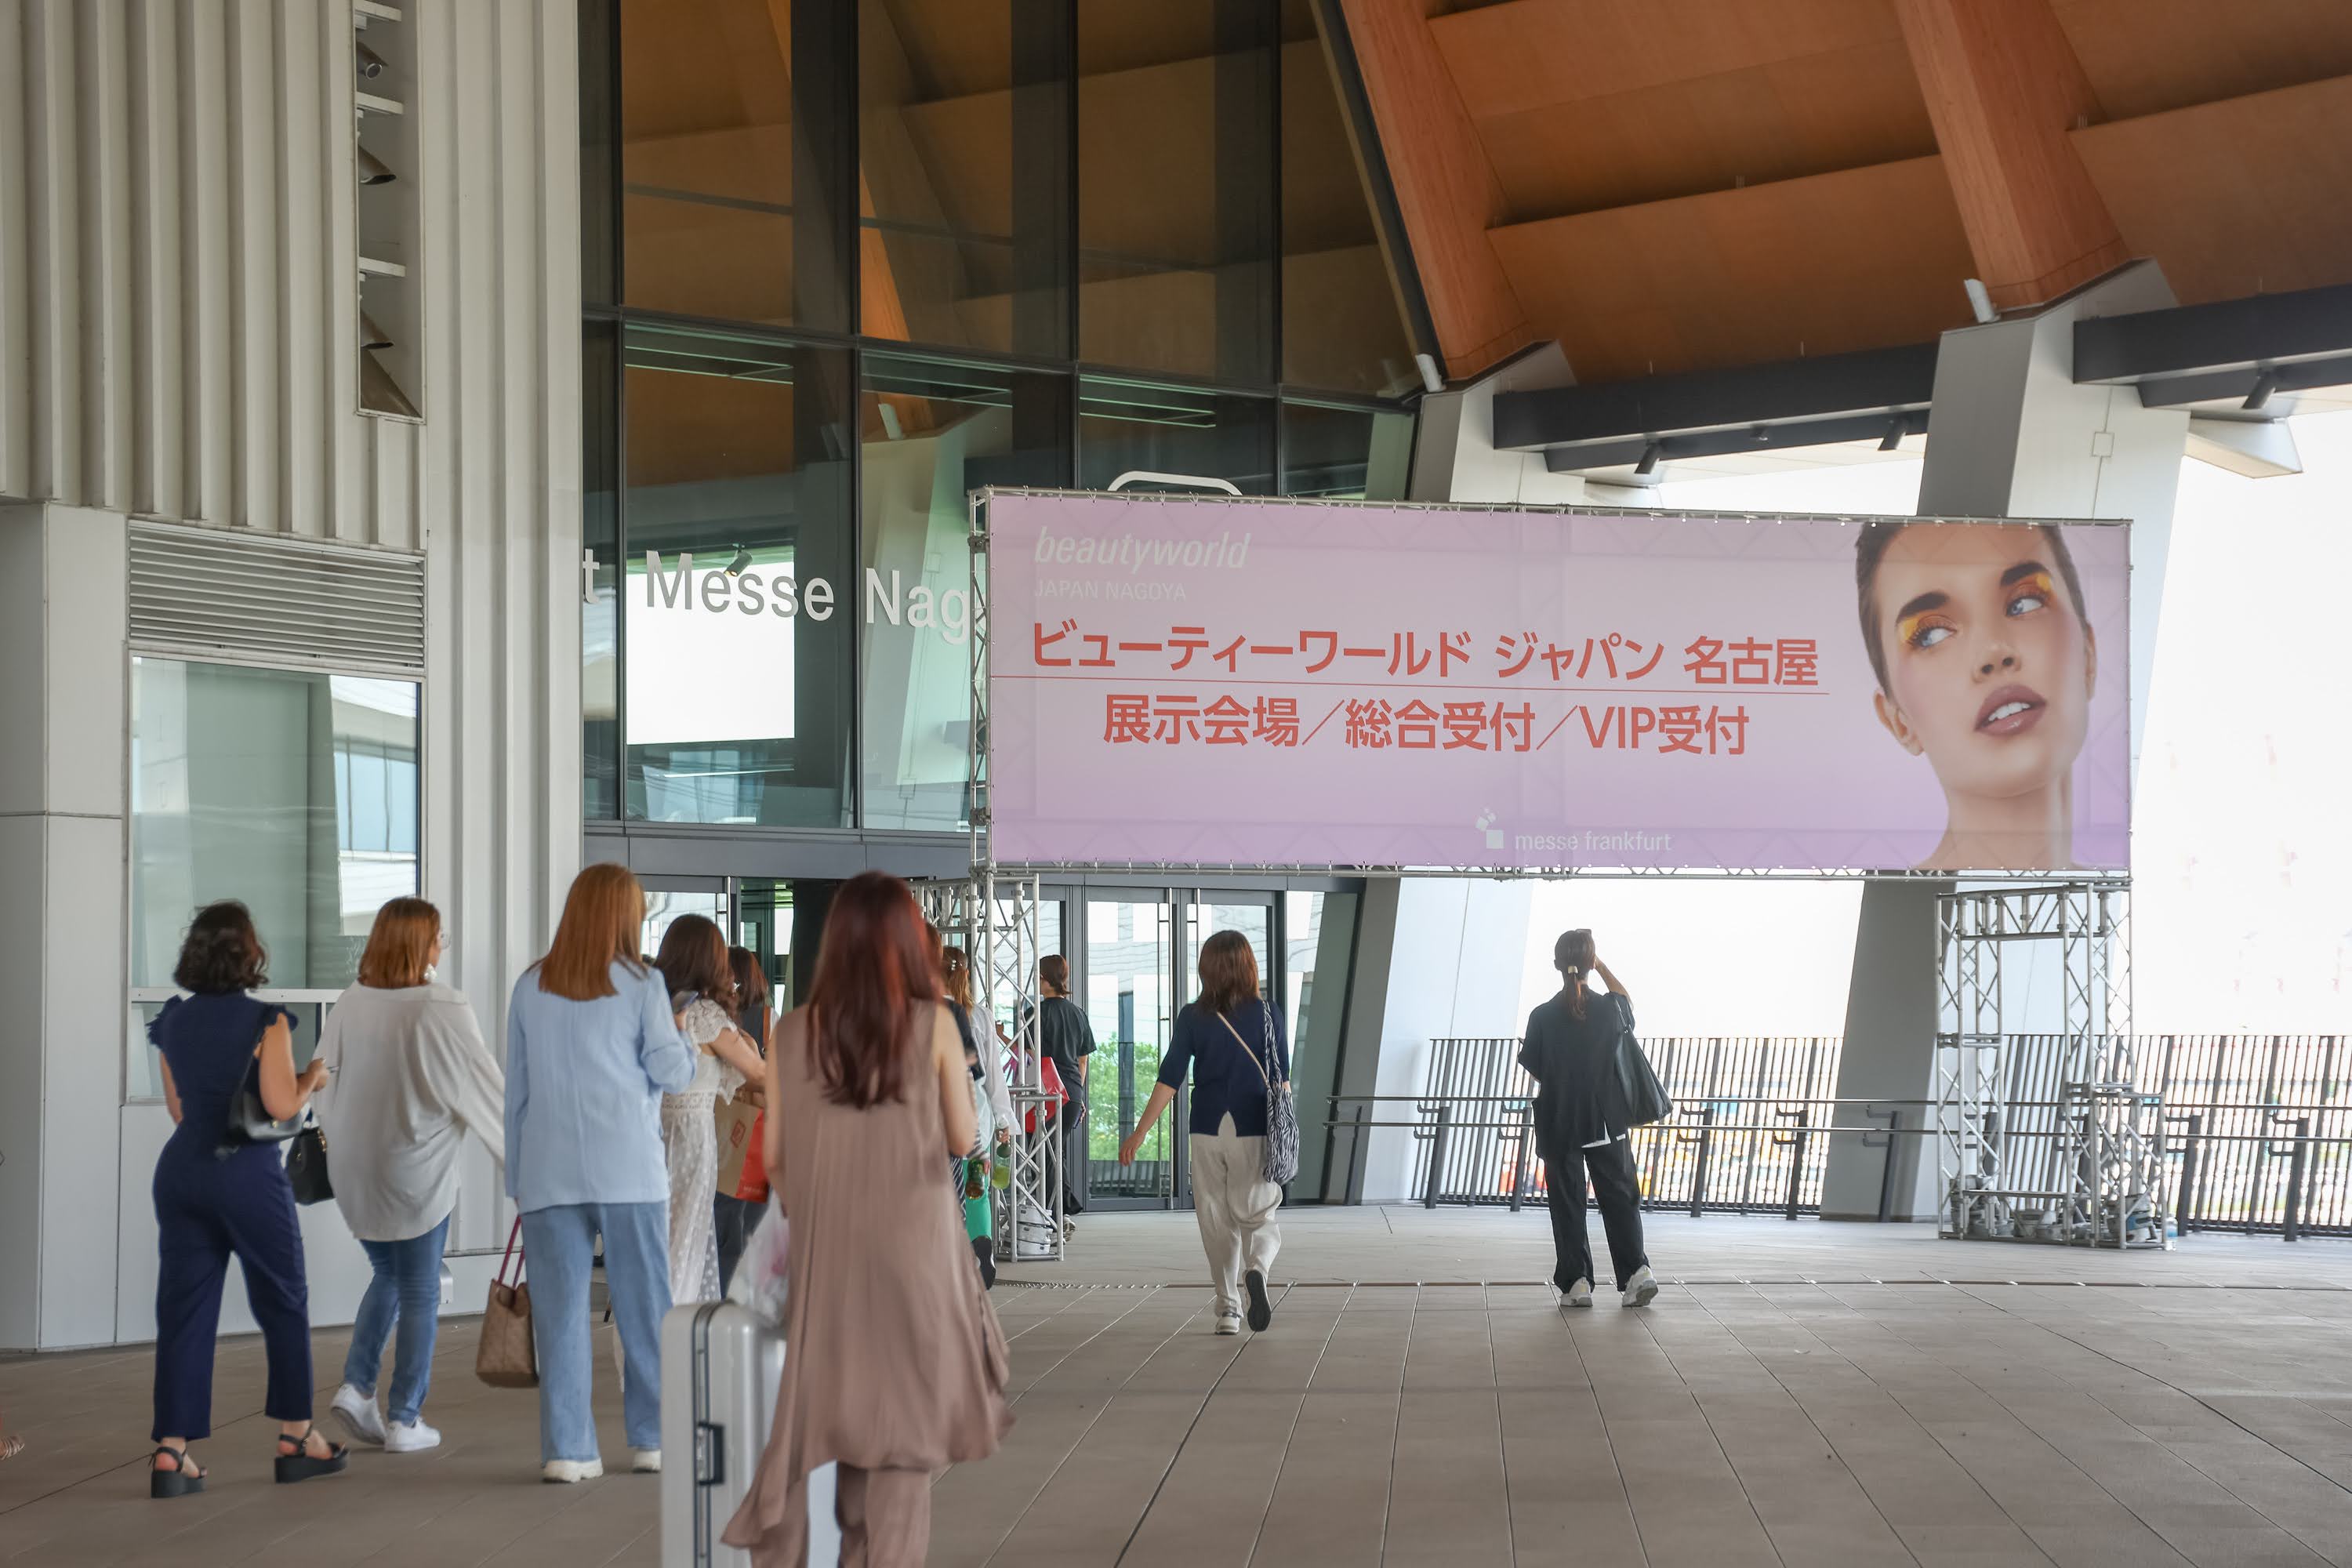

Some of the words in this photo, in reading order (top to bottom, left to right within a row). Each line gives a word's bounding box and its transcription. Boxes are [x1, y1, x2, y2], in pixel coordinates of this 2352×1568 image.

[1034, 525, 1252, 575] beautyworld
[645, 550, 834, 622] Messe
[866, 568, 987, 645] Nag
[1034, 579, 1098, 598] JAPAN
[1105, 581, 1187, 601] NAGOYA
[1033, 618, 1472, 677] ビューティーワールド
[1495, 631, 1665, 681] ジャパン
[1683, 635, 1819, 686] 名古屋
[1515, 835, 1578, 851] messe
[1585, 830, 1672, 851] frankfurt
